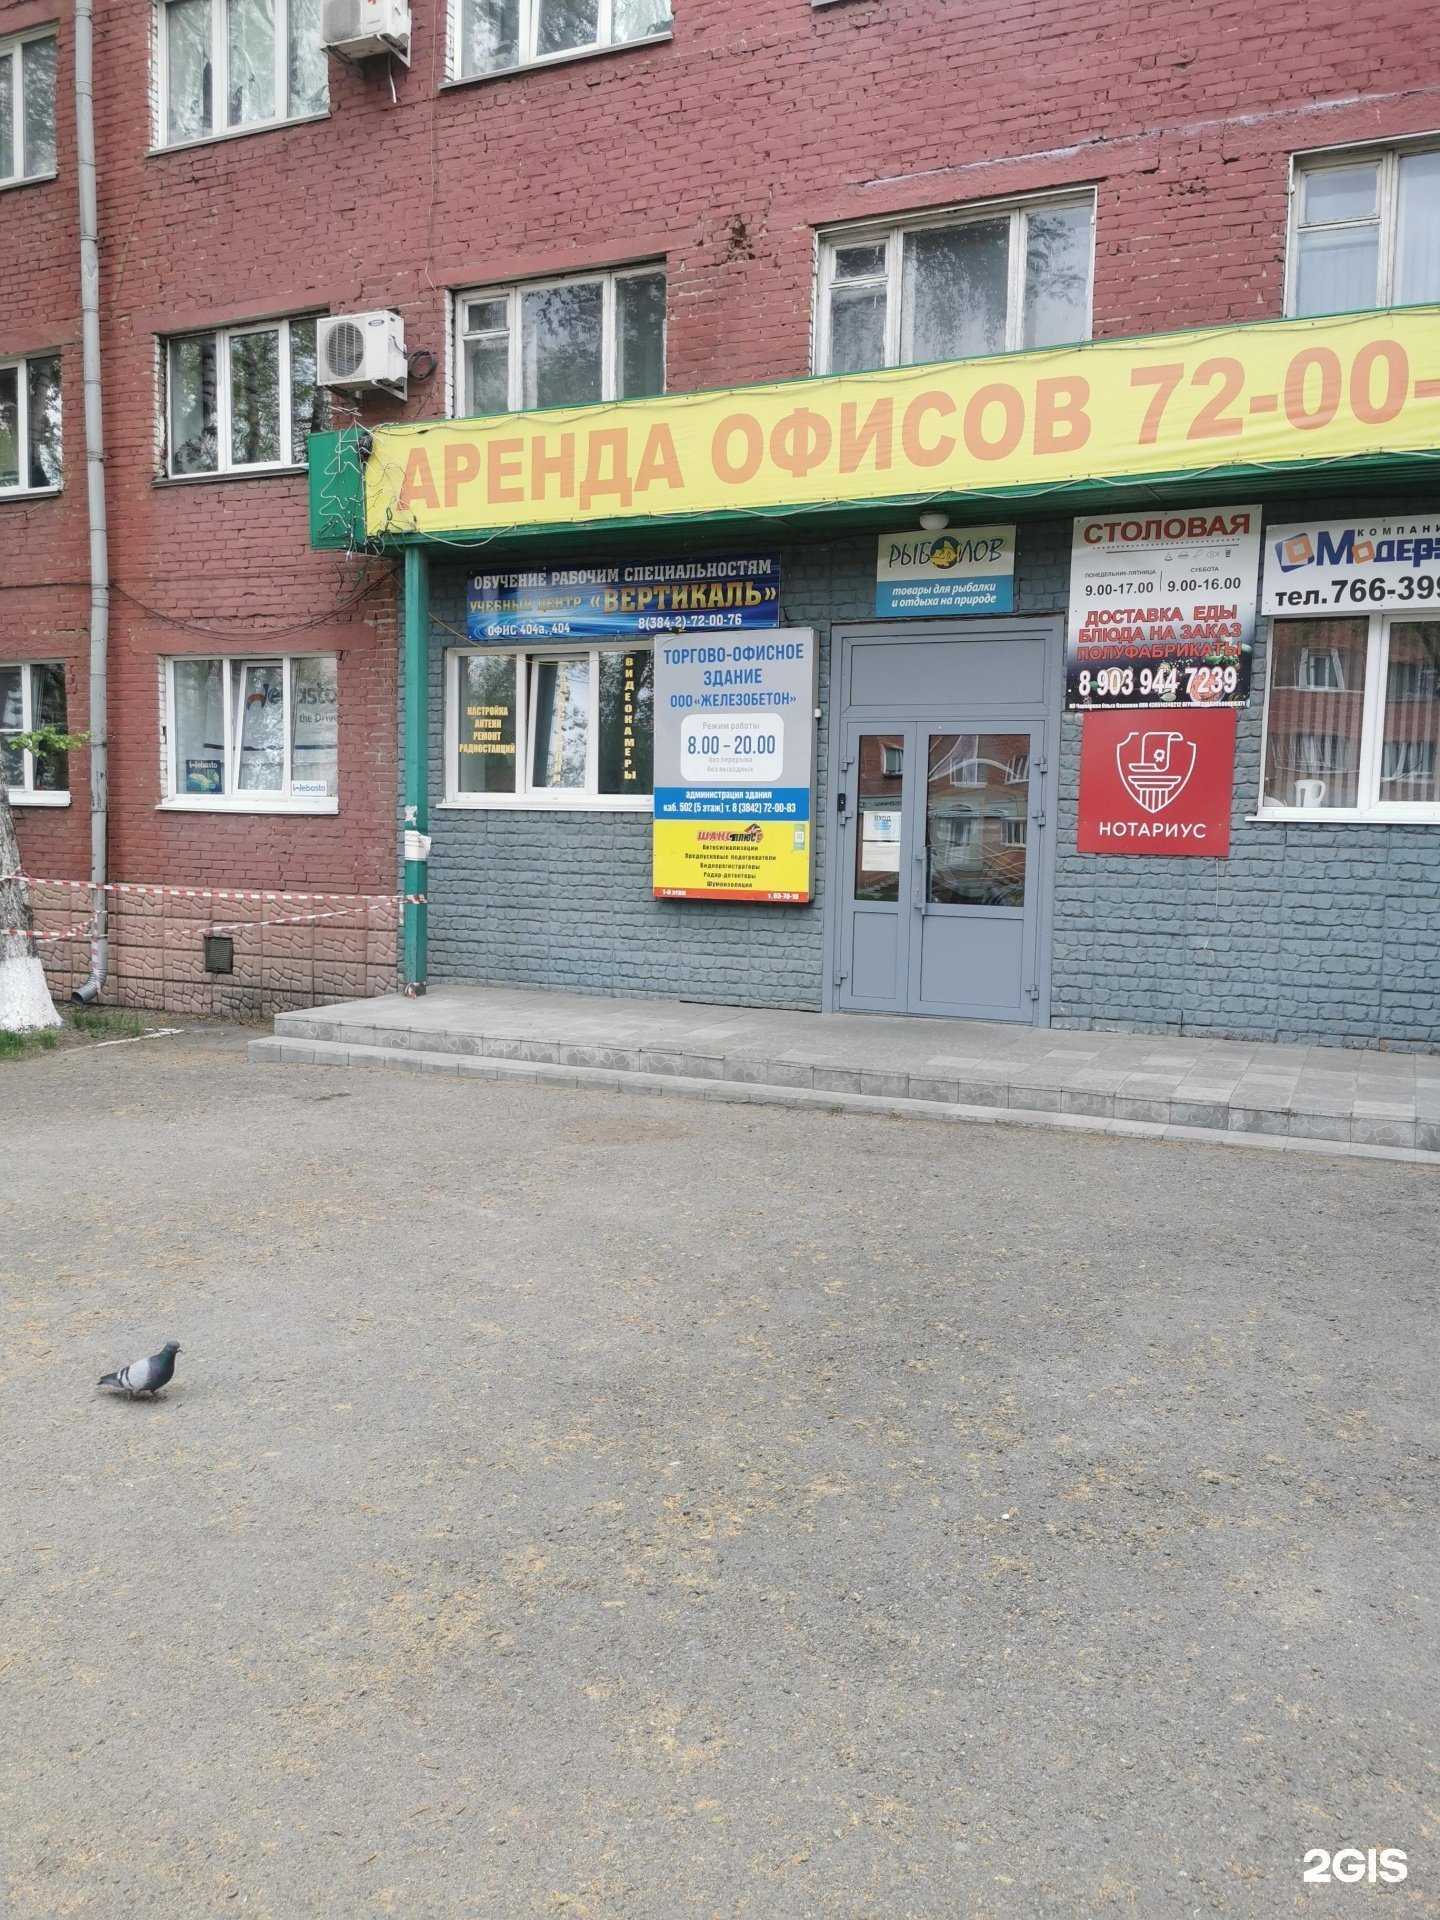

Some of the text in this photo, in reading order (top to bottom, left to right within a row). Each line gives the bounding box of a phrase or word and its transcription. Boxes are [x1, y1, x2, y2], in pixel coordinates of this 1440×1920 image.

[396, 423, 685, 511] АРЕНДА
[711, 376, 1093, 484] ОФИСОВ
[1084, 512, 1251, 544] СТОЛОВАЯ
[474, 559, 771, 590] ОБУЧЕНИЕ РАБОЧИМ СПЕЦИАЛЬНОСТЯМ
[892, 582, 996, 596] товары для рыбалки
[1085, 582, 1154, 596] 9.00-17.00
[1167, 577, 1241, 592] 9.00-16.00
[590, 581, 777, 613] «ВЕРТИКАЛЬ»
[891, 593, 997, 608] и отдыха на природе
[1085, 604, 1237, 627] ДОСТАВКА ЕДЫ
[487, 624, 517, 636] ОФИС
[1079, 622, 1242, 643] БЛЮДА НА ЗАКАЗ
[664, 643, 805, 665] ТОРГОВО-ОФИСНОЕ
[1077, 641, 1242, 662] ПОЛУФАБРИКАТЫ
[703, 668, 763, 687] ЗДАНИЕ
[1078, 670, 1091, 696] 8
[1097, 668, 1134, 696] 903
[1185, 666, 1238, 694] 7239
[670, 691, 797, 708] ООО «ЖЕЛЕЗОБЕТОН»
[730, 721, 760, 731] работы
[473, 731, 502, 741] РЕМОНТ
[686, 790, 772, 801] администрация здания
[663, 803, 678, 812] каб.
[1099, 821, 1207, 839] НОТАРИУС
